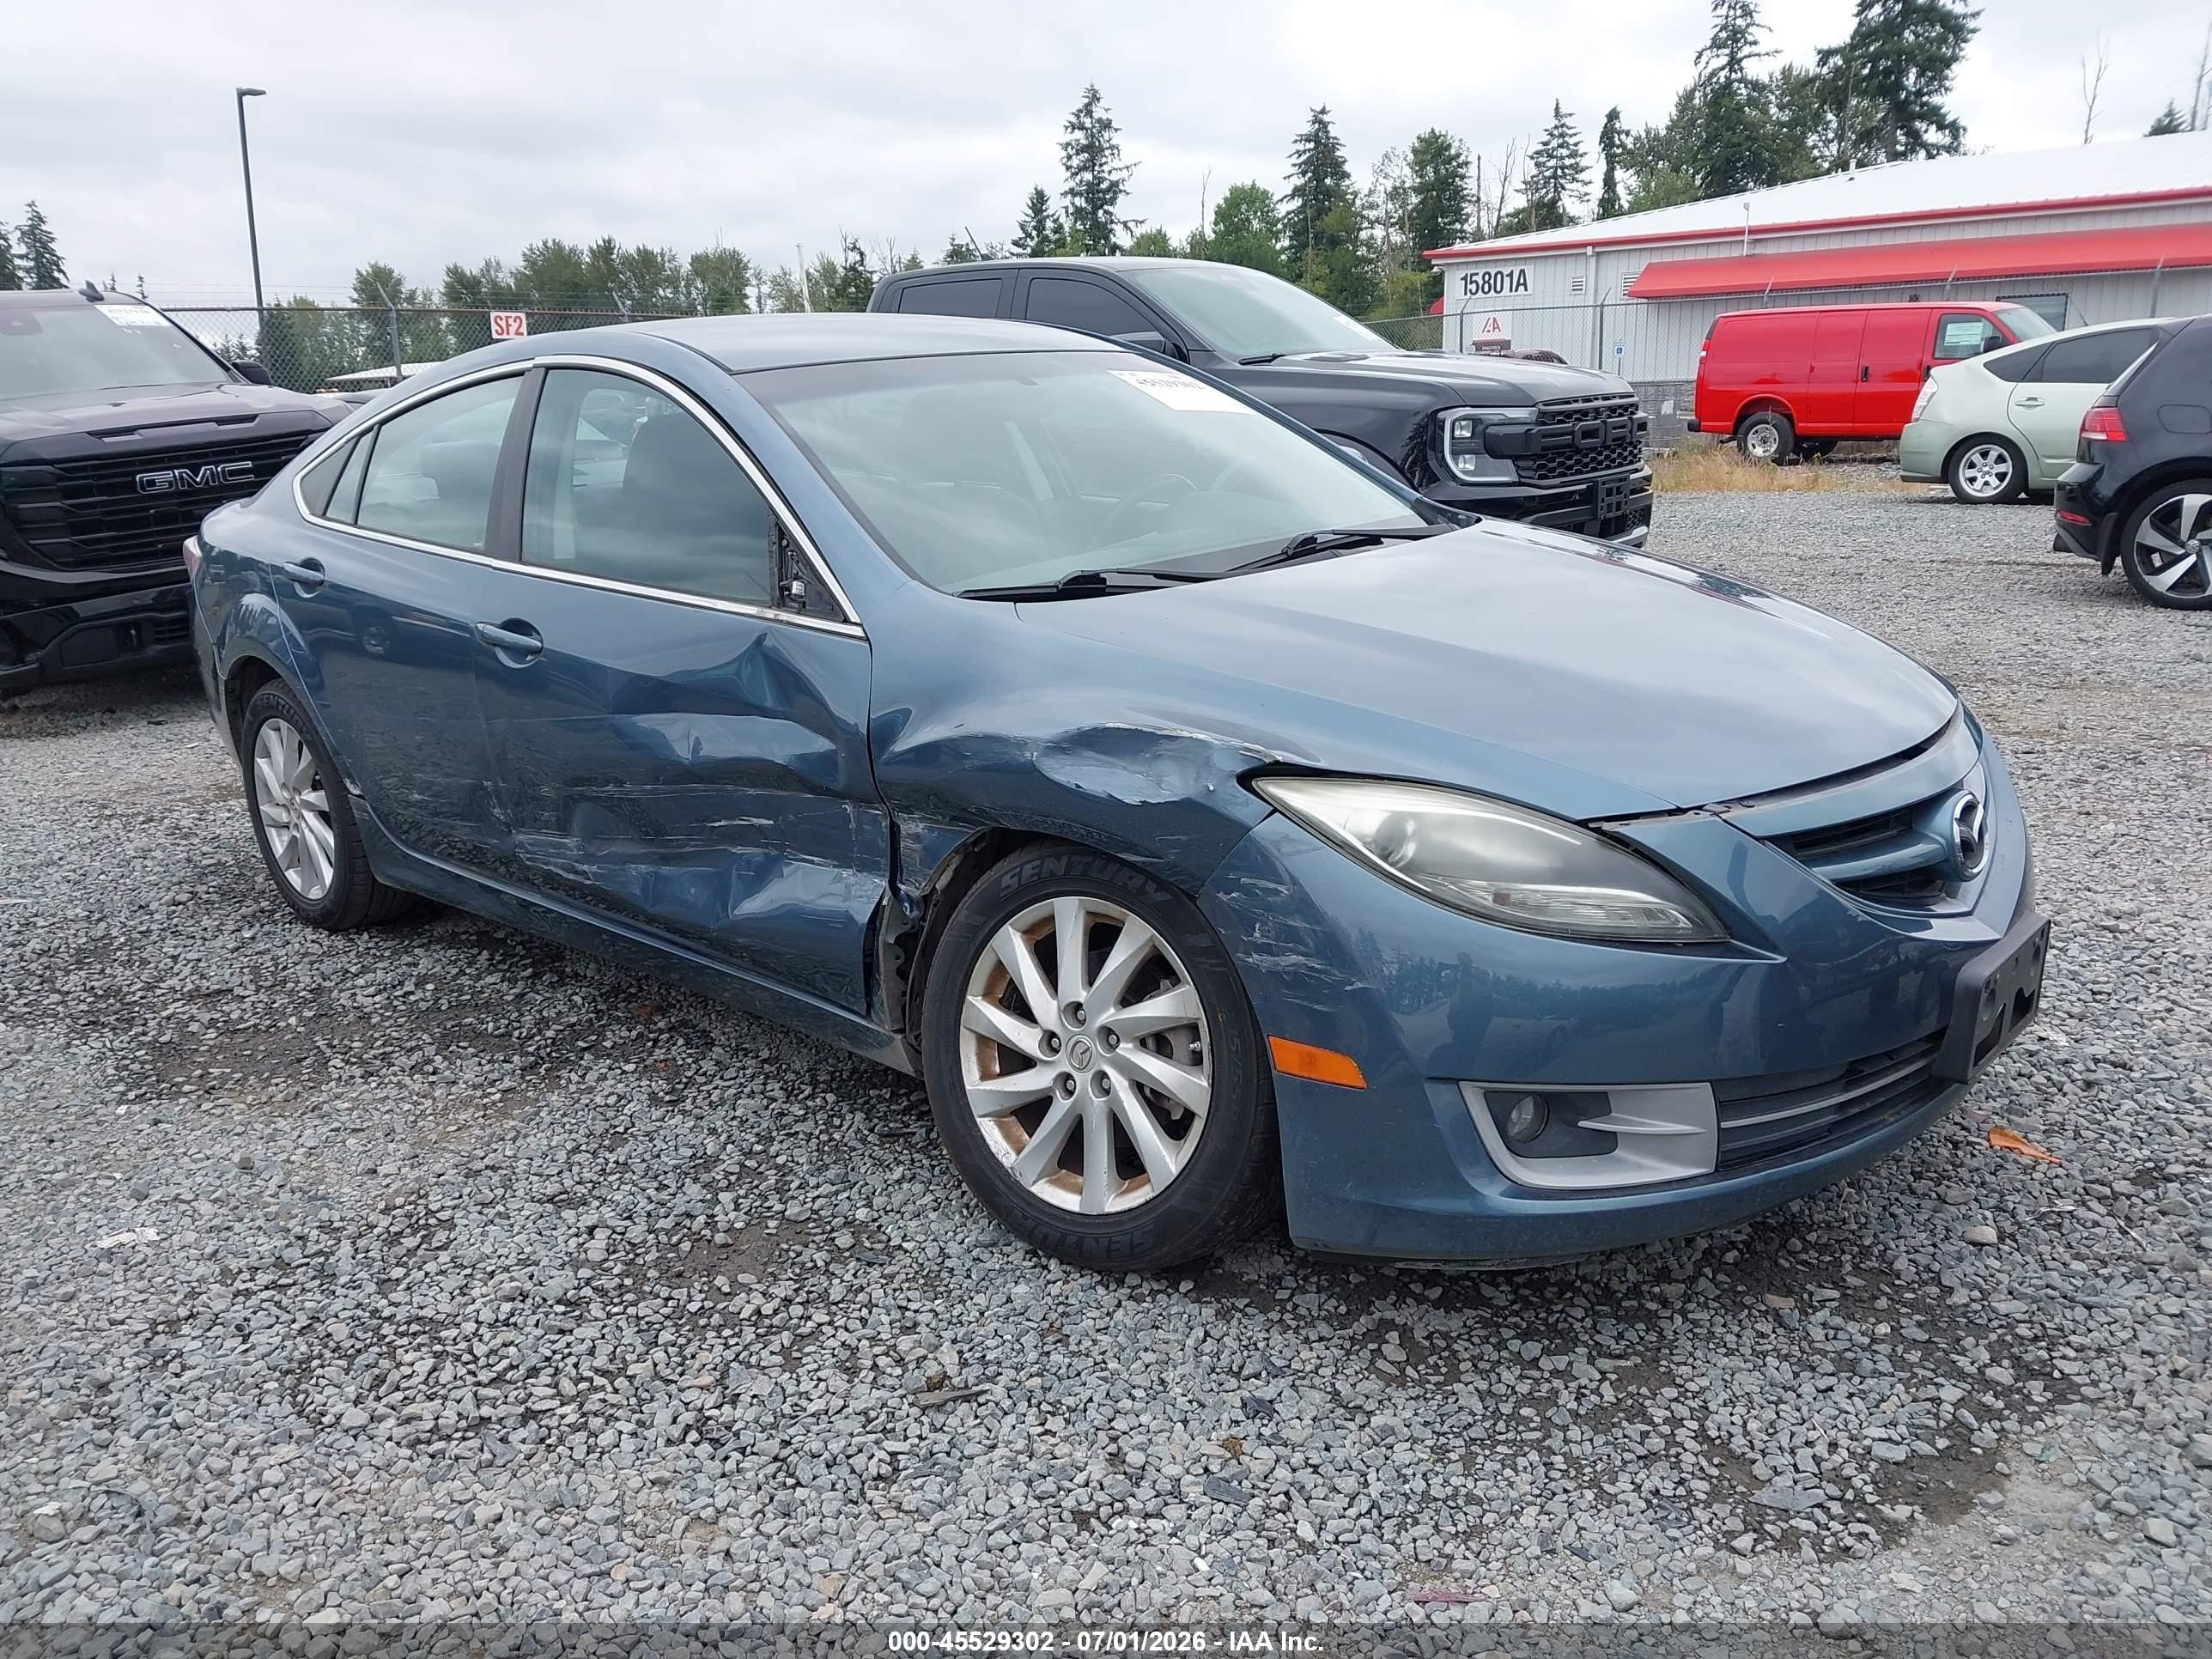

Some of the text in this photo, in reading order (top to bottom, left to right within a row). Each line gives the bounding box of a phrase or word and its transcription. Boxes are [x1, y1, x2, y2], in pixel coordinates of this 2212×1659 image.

[1460, 268, 1528, 296] 15801A
[494, 314, 524, 336] SF2
[137, 461, 254, 494] GMC
[1000, 855, 1176, 900] SENTURY
